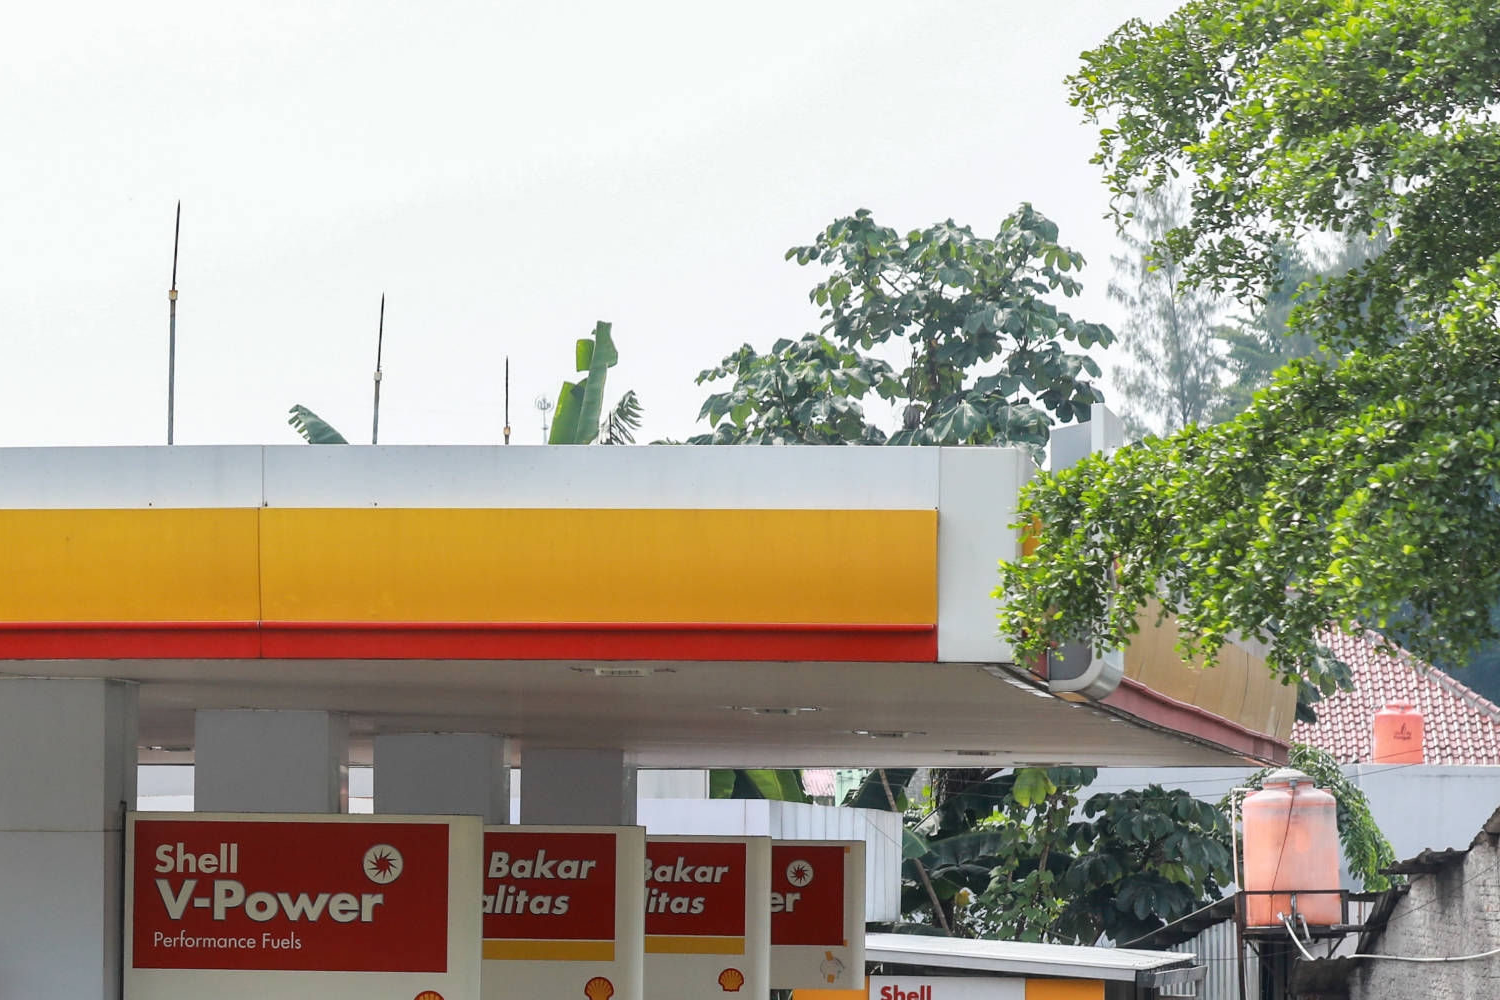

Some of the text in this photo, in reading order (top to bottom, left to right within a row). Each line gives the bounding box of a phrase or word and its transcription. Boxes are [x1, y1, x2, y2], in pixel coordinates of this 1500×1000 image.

[154, 842, 239, 874] Shell
[488, 850, 597, 880] Bakar
[154, 878, 385, 923] V-Power
[153, 930, 302, 950] Performance Fuels
